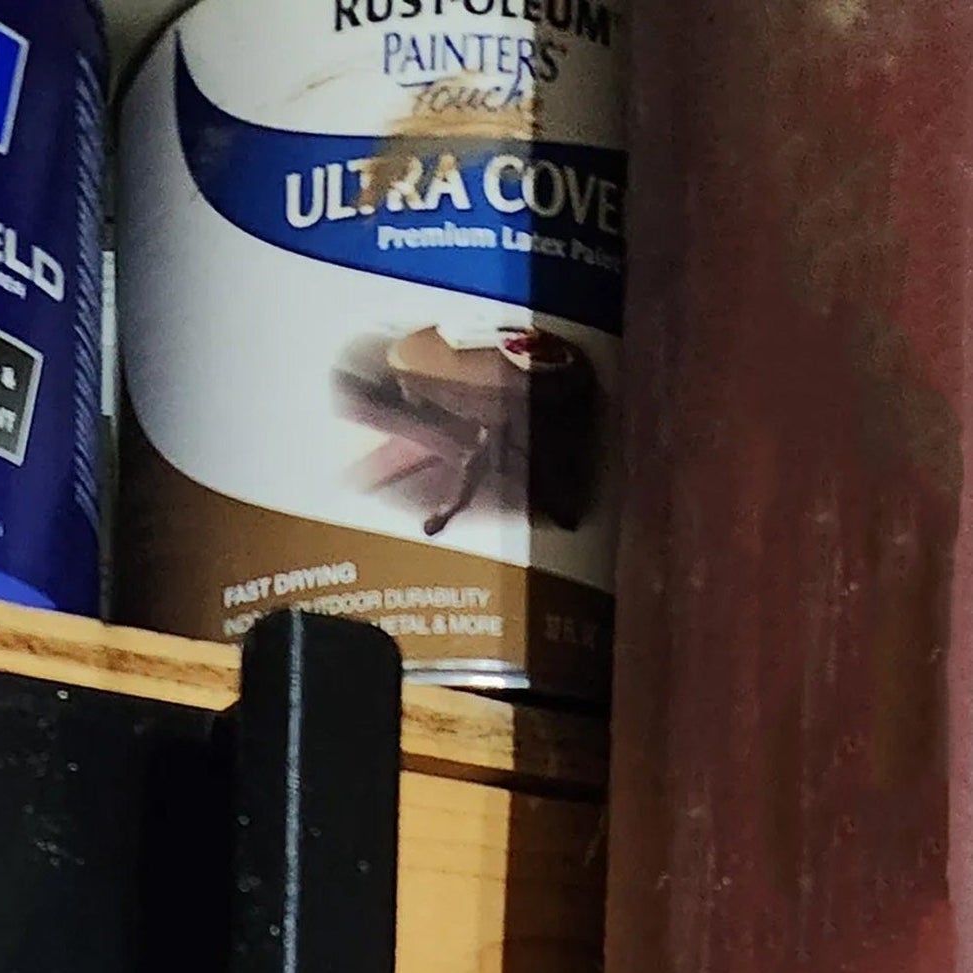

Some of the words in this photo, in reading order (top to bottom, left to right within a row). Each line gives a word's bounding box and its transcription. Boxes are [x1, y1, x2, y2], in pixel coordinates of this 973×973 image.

[286, 153, 472, 228] ULTRA
[484, 153, 619, 234] COVE
[377, 221, 497, 250] Premium
[502, 227, 564, 258] Latex
[223, 574, 273, 609] FAST
[274, 561, 358, 596] DRYING
[384, 586, 492, 610] DURABILITY
[433, 616, 447, 635] &
[448, 614, 505, 638] MORE
